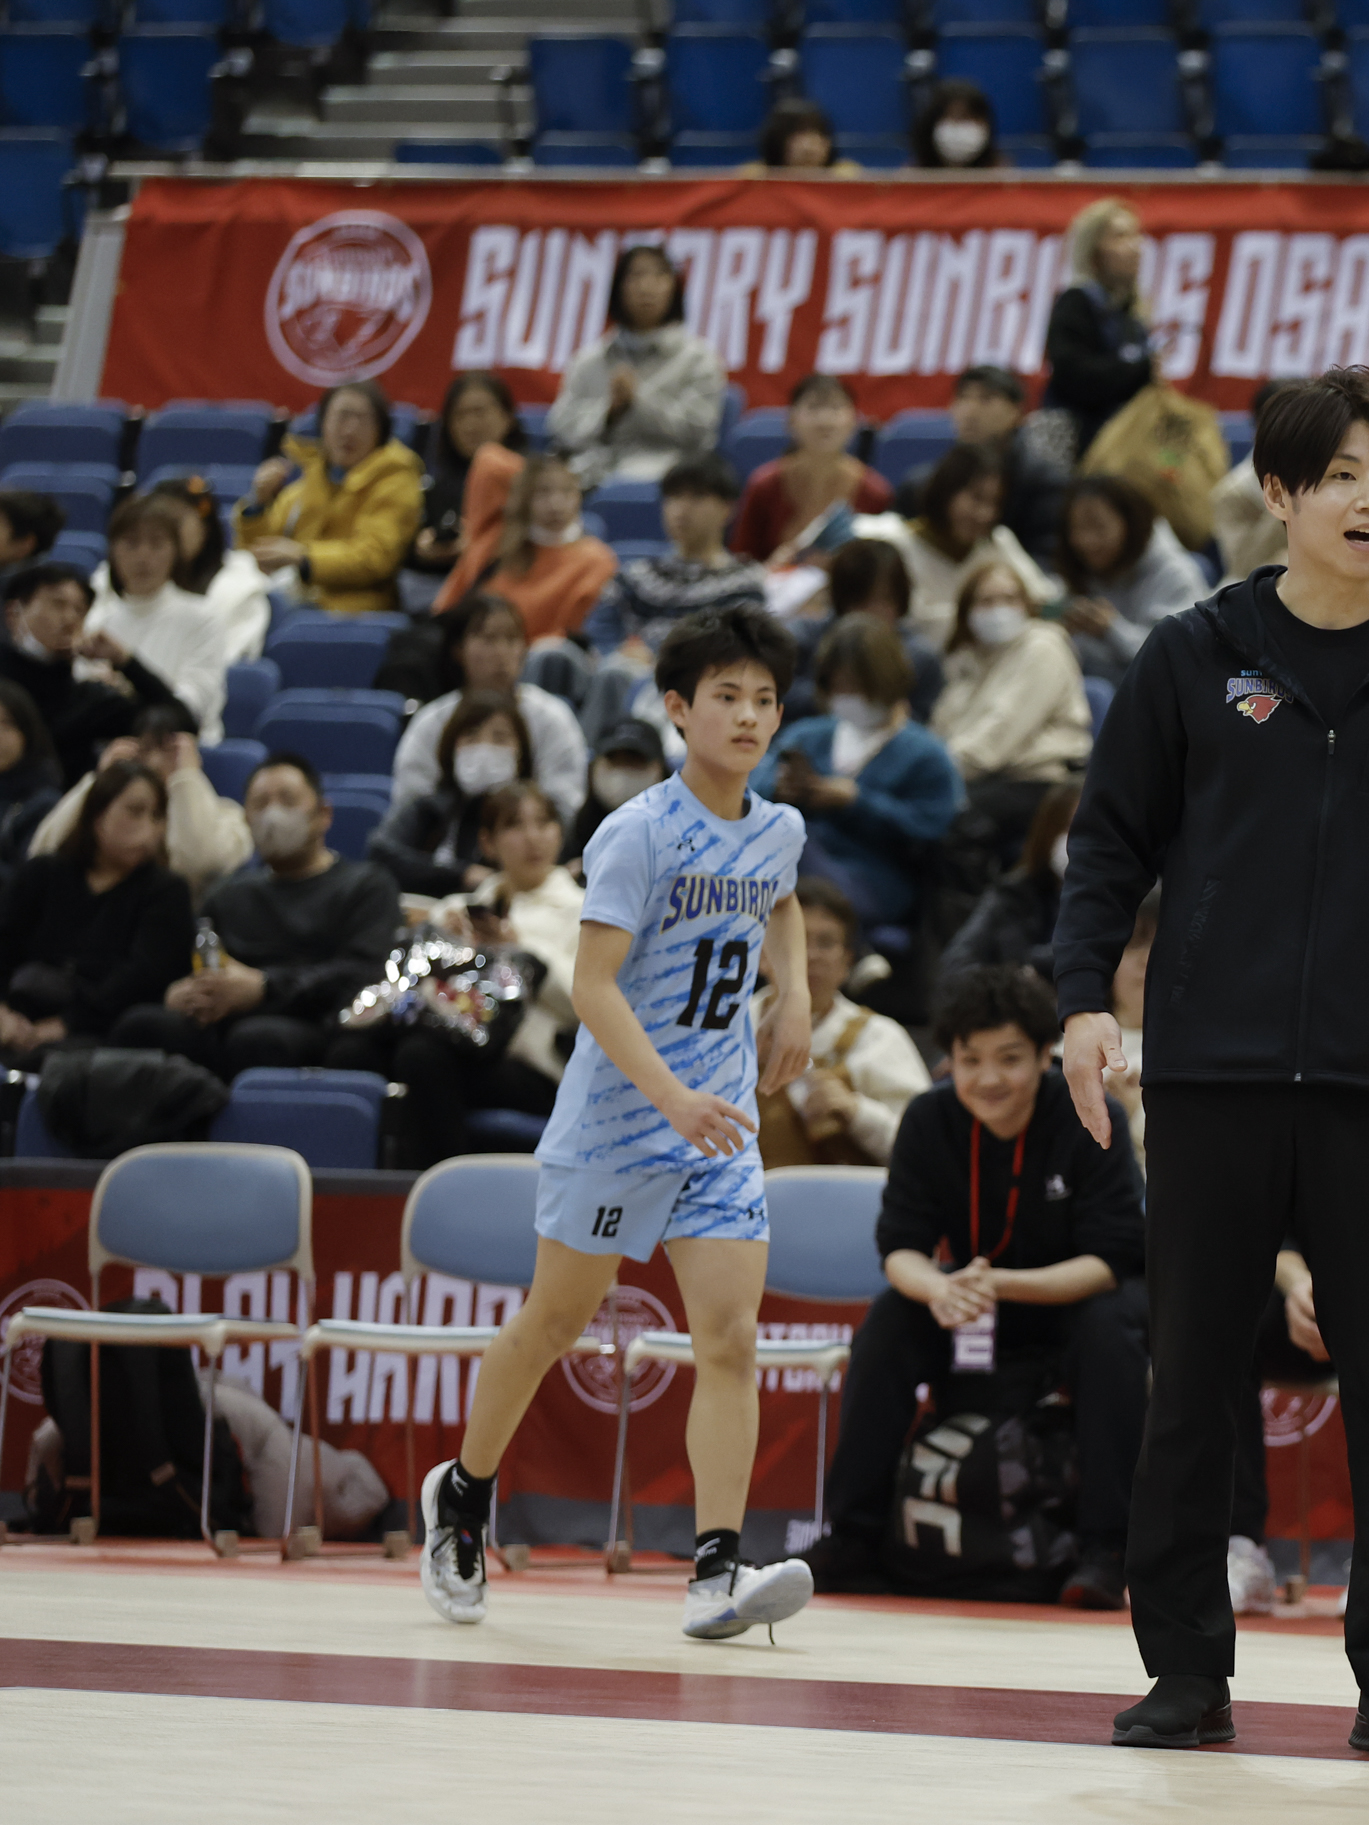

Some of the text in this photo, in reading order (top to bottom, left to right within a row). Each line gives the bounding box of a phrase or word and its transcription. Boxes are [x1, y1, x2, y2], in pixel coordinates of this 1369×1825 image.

[451, 226, 818, 373] SUNORY
[814, 227, 1215, 378] SUNBIS
[676, 938, 749, 1030] 12
[591, 1206, 623, 1237] 12
